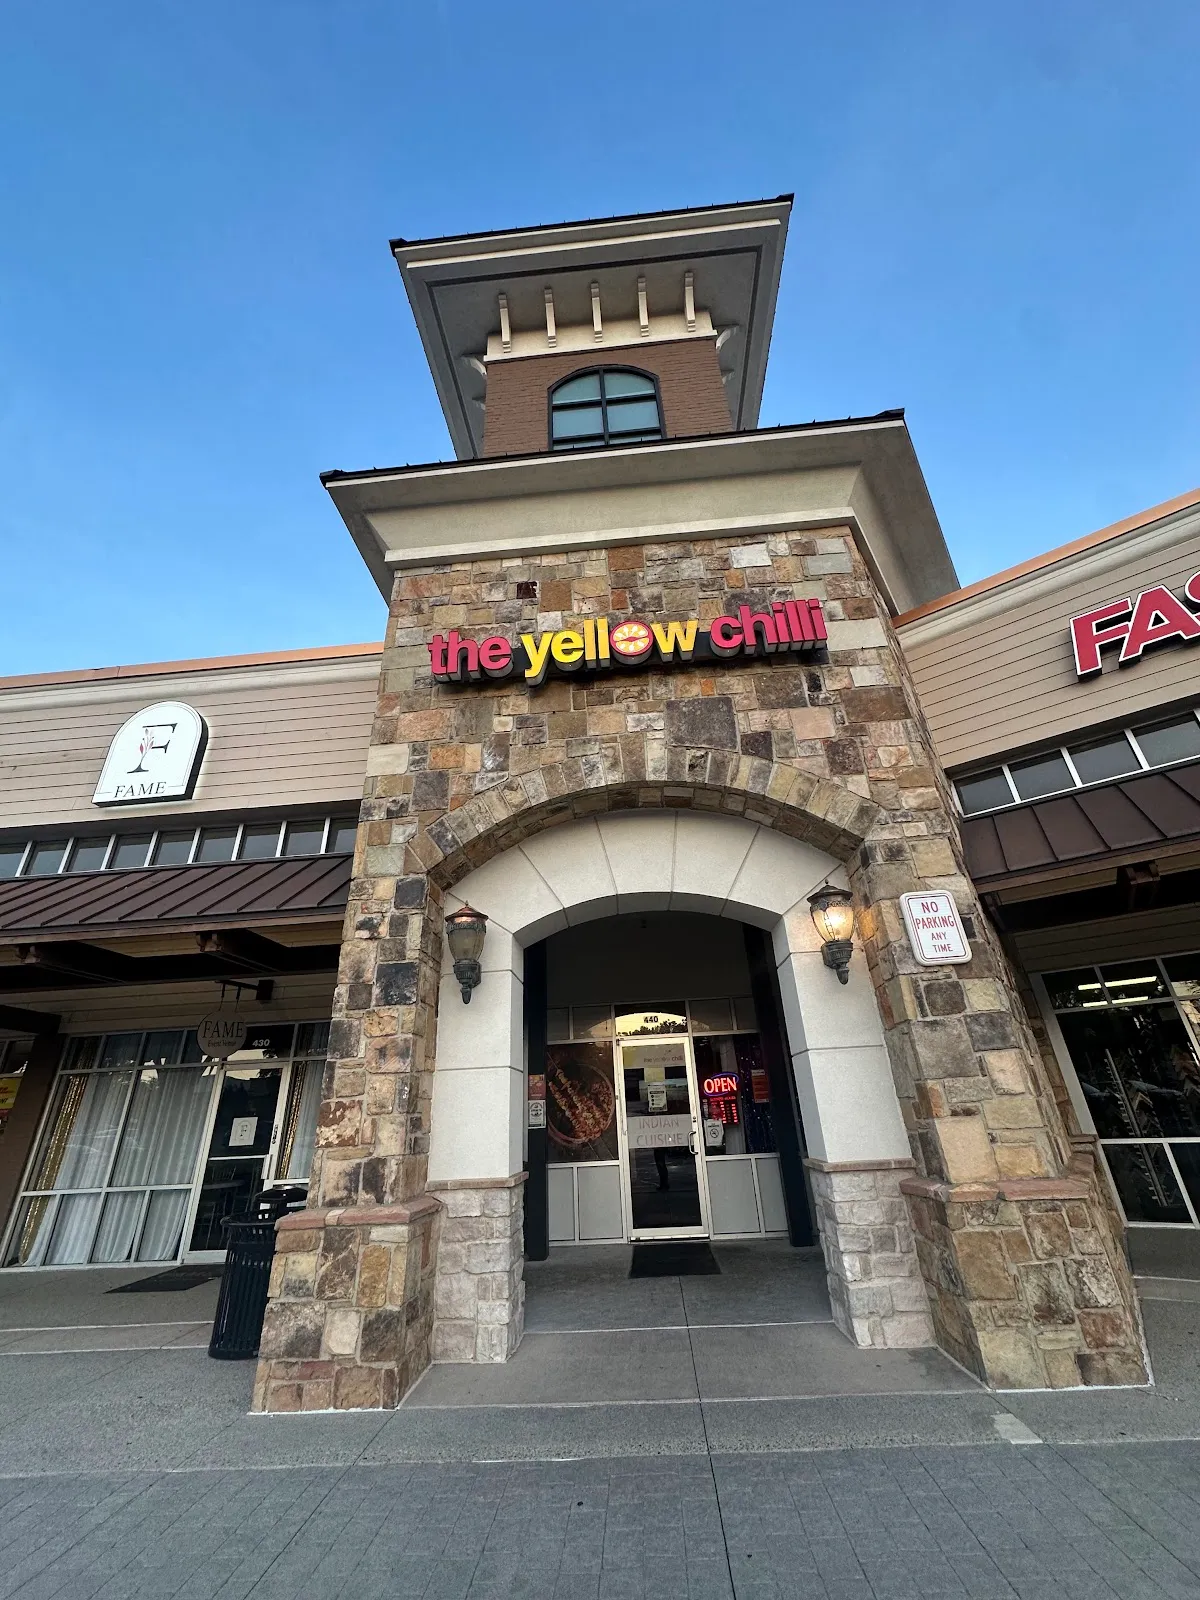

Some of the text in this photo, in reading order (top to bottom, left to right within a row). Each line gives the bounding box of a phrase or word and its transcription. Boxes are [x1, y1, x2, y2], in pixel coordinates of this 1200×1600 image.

[1070, 571, 1200, 676] FA
[428, 598, 829, 681] the yellow chilli
[113, 781, 167, 798] FAME
[921, 901, 939, 913] NO
[915, 915, 955, 930] PARKING
[931, 931, 947, 941] ANY
[933, 943, 954, 953] TIME
[644, 1015, 659, 1024] 440
[202, 1020, 245, 1038] FAME
[252, 1038, 271, 1047] 430
[703, 1076, 738, 1094] OPEN
[639, 1116, 680, 1129] INDIAN
[636, 1133, 684, 1147] CUISINE
